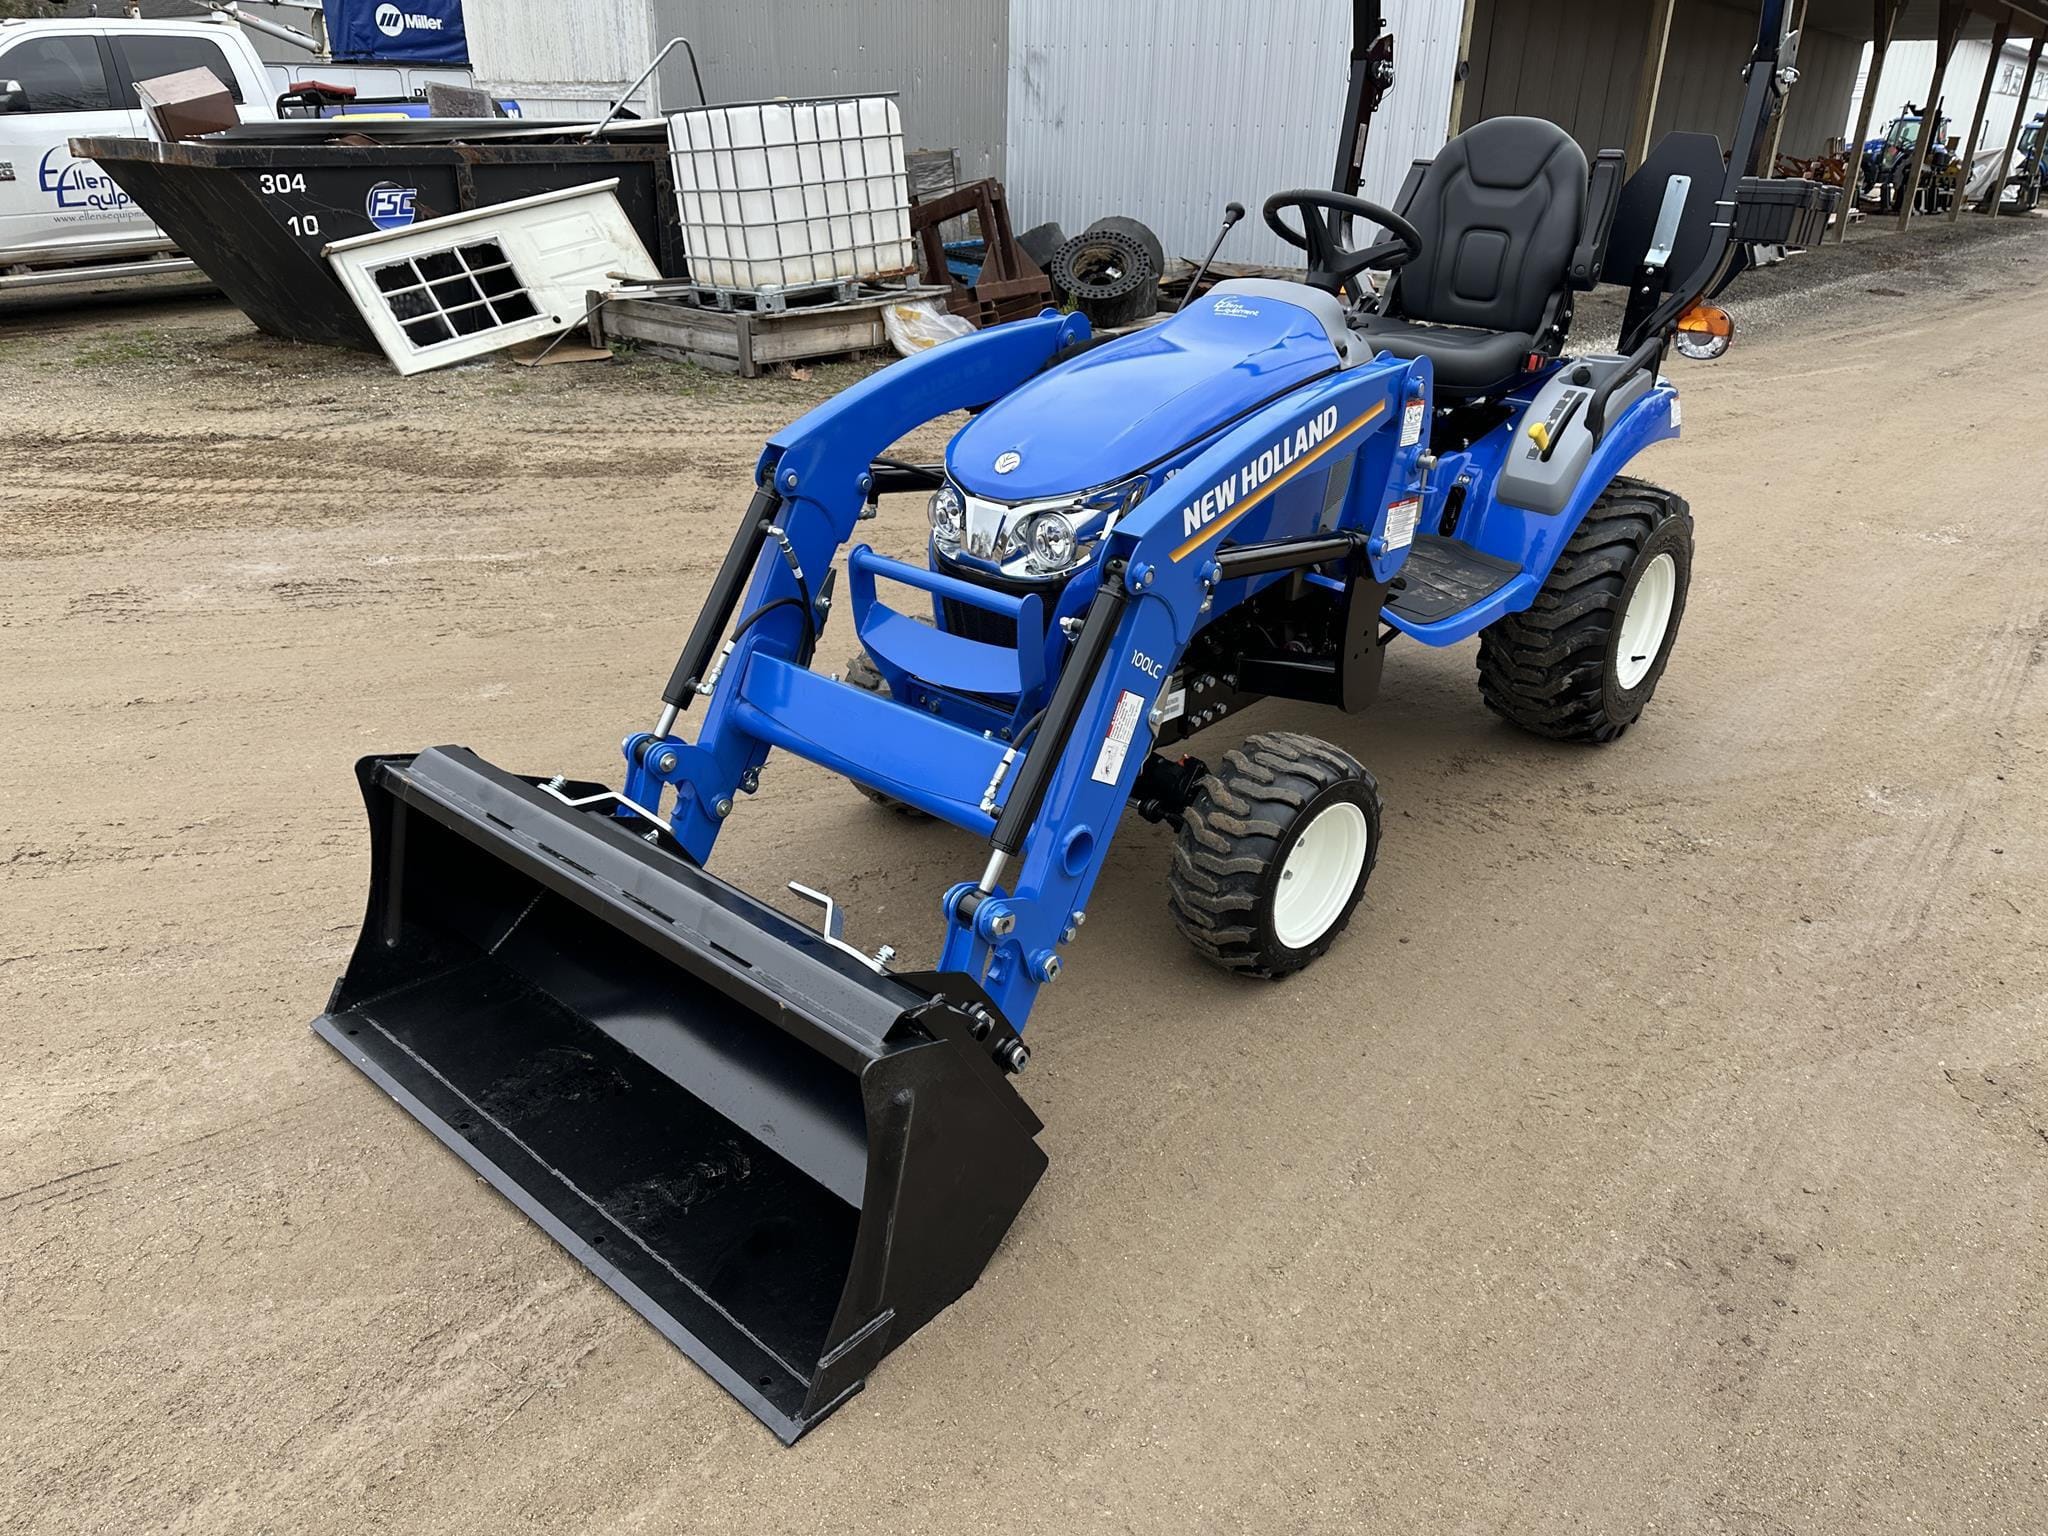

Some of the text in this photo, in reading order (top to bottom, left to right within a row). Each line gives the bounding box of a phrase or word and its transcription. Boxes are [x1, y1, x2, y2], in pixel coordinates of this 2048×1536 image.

[404, 14, 443, 30] Miller
[57, 160, 134, 210] Equip
[260, 173, 307, 194] 304
[371, 189, 417, 217] FSC
[287, 215, 319, 236] 10
[1183, 405, 1338, 538] NEW HOLLAND
[1131, 649, 1163, 680] 100LC
